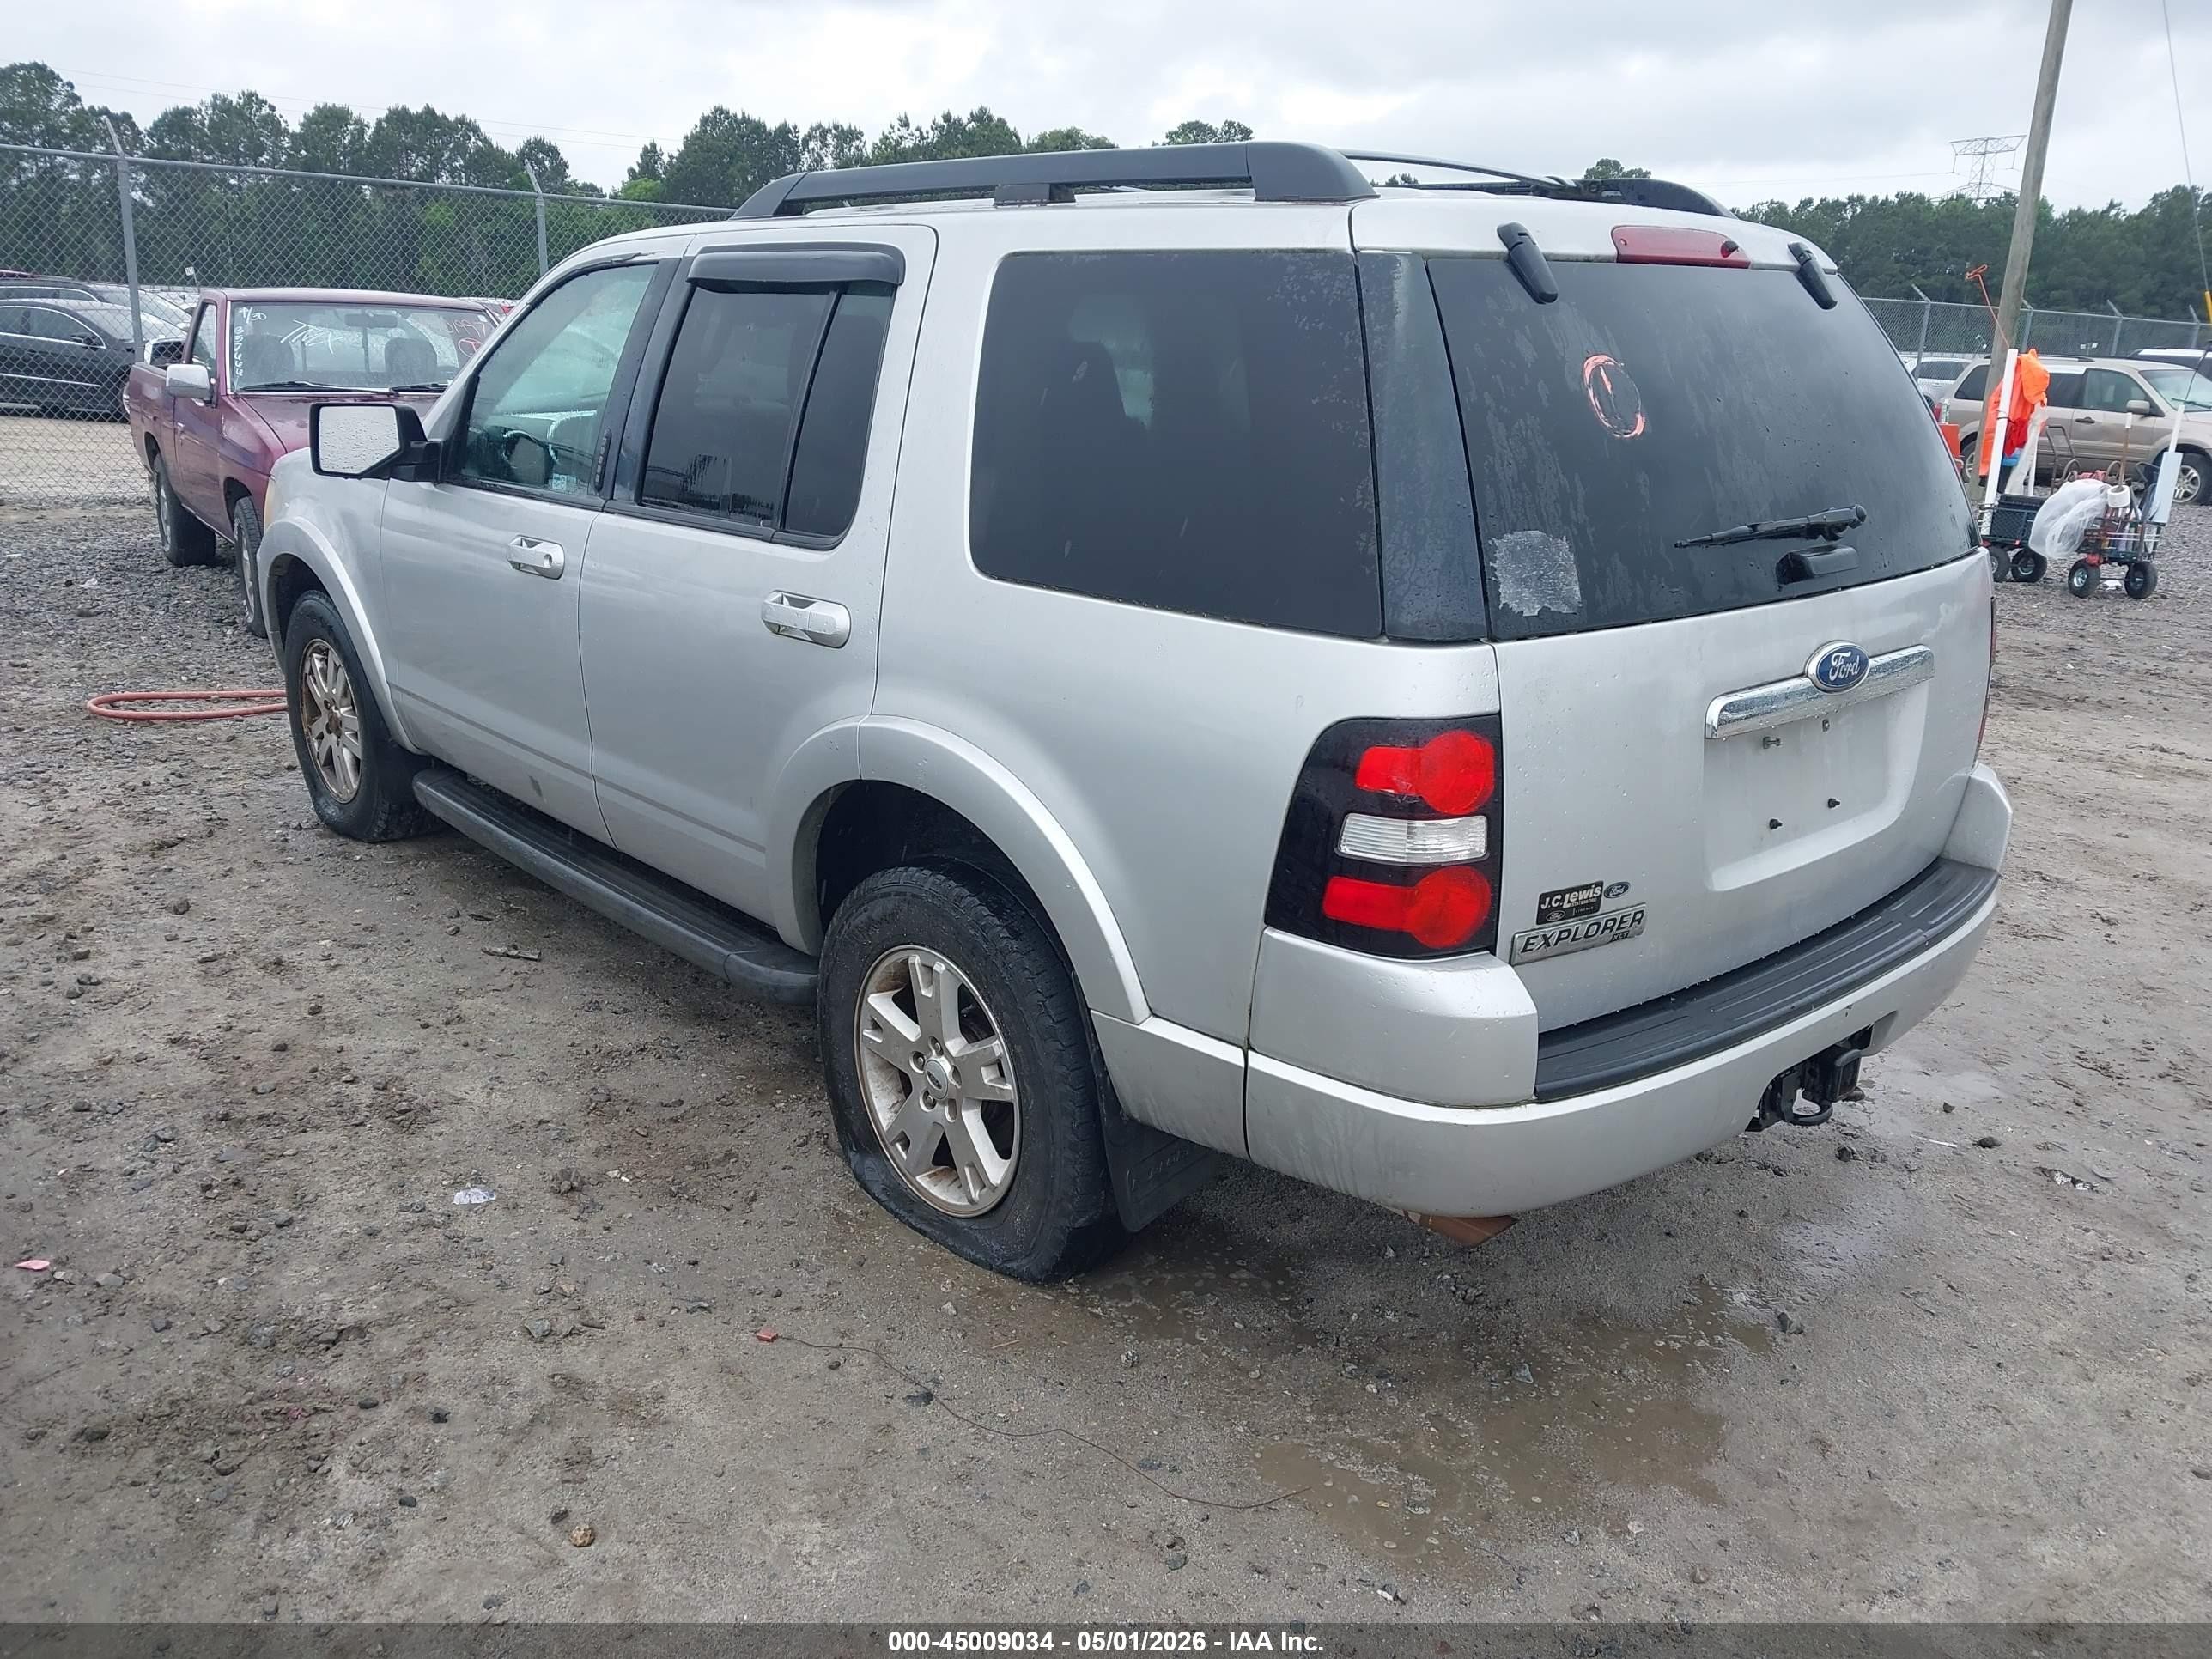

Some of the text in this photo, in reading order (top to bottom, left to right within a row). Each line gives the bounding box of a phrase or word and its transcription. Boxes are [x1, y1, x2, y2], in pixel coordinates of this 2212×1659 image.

[1607, 884, 1629, 897] Ford
[1520, 909, 1645, 954] EXPLORER
[1612, 931, 1630, 942] XLT
